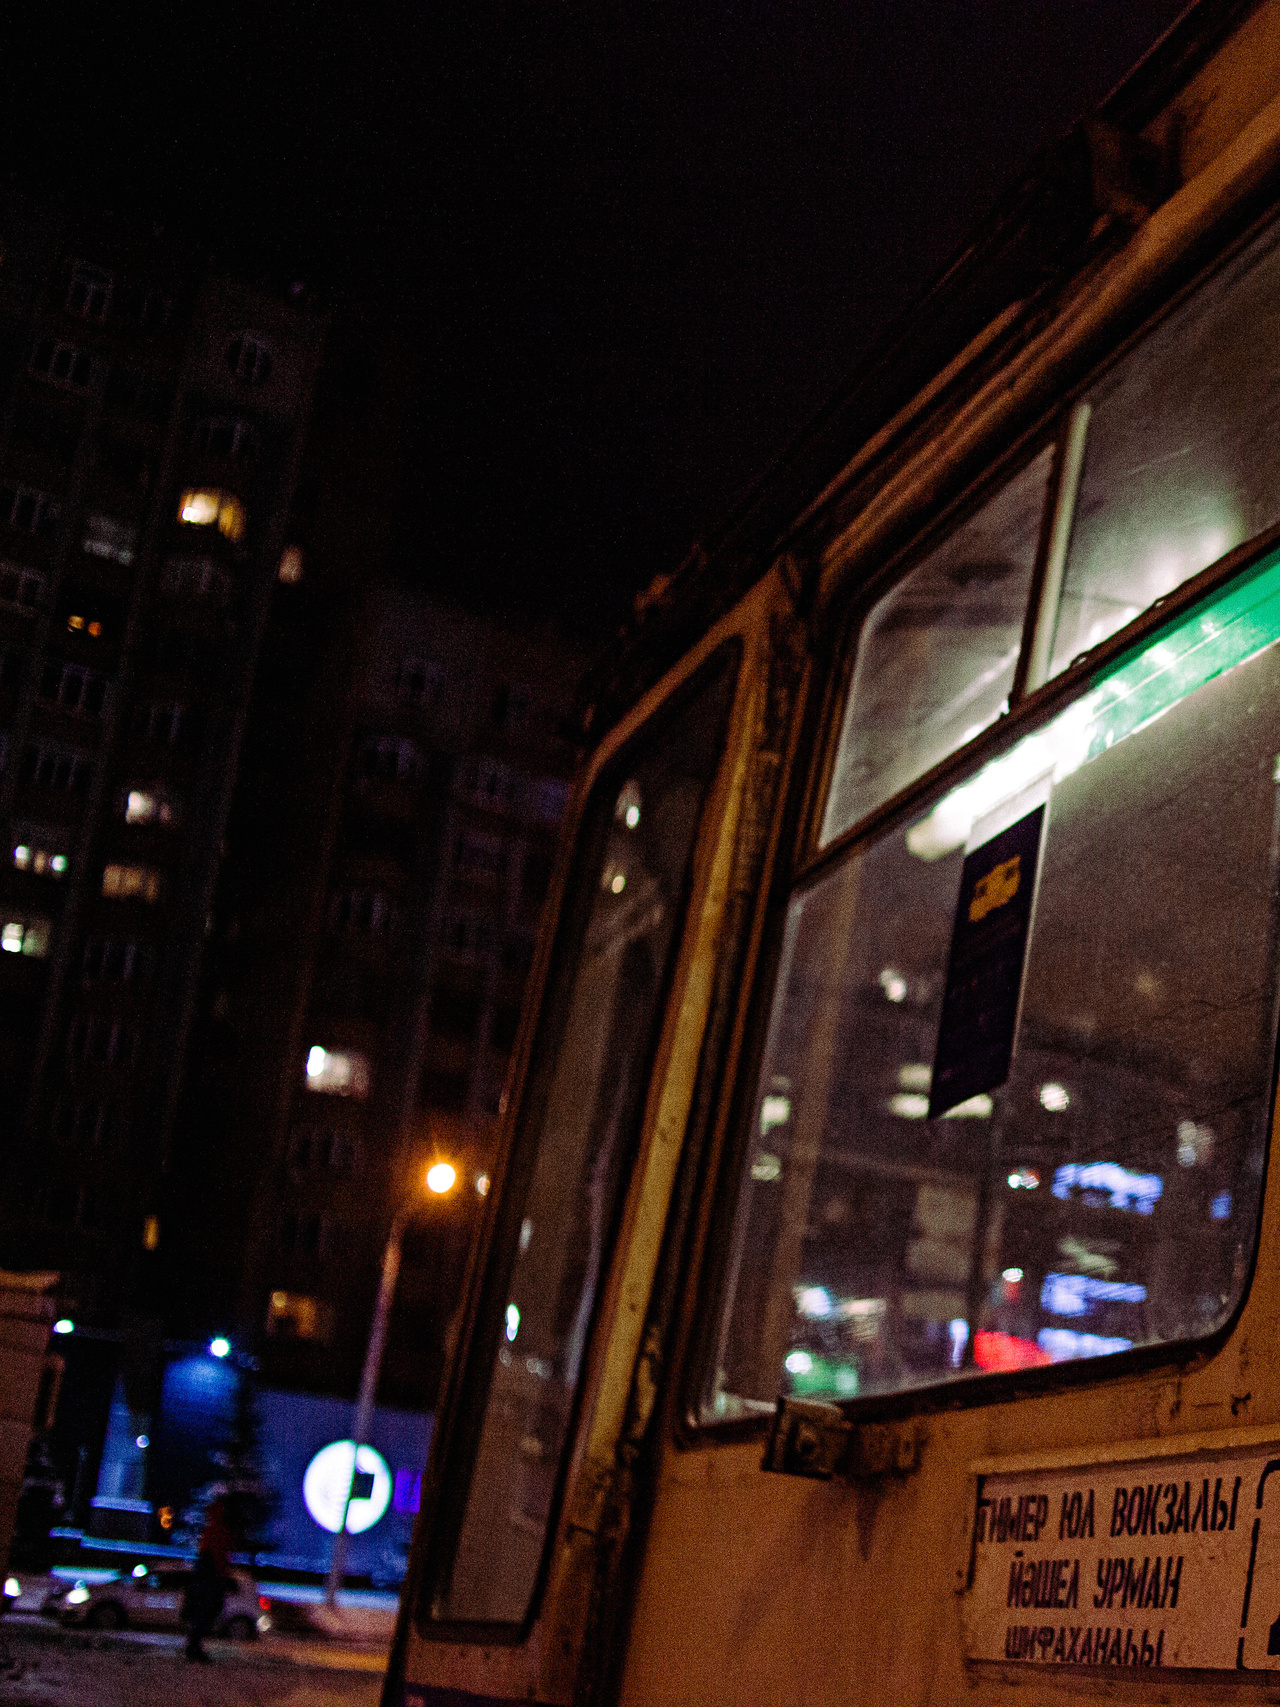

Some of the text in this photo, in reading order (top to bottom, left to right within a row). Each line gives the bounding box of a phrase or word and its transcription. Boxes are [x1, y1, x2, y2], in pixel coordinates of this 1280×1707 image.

[1059, 1489, 1095, 1541] ЮЛ
[1110, 1476, 1242, 1538] ВОКЗАЛЫ
[1093, 1556, 1184, 1609] УРМАН
